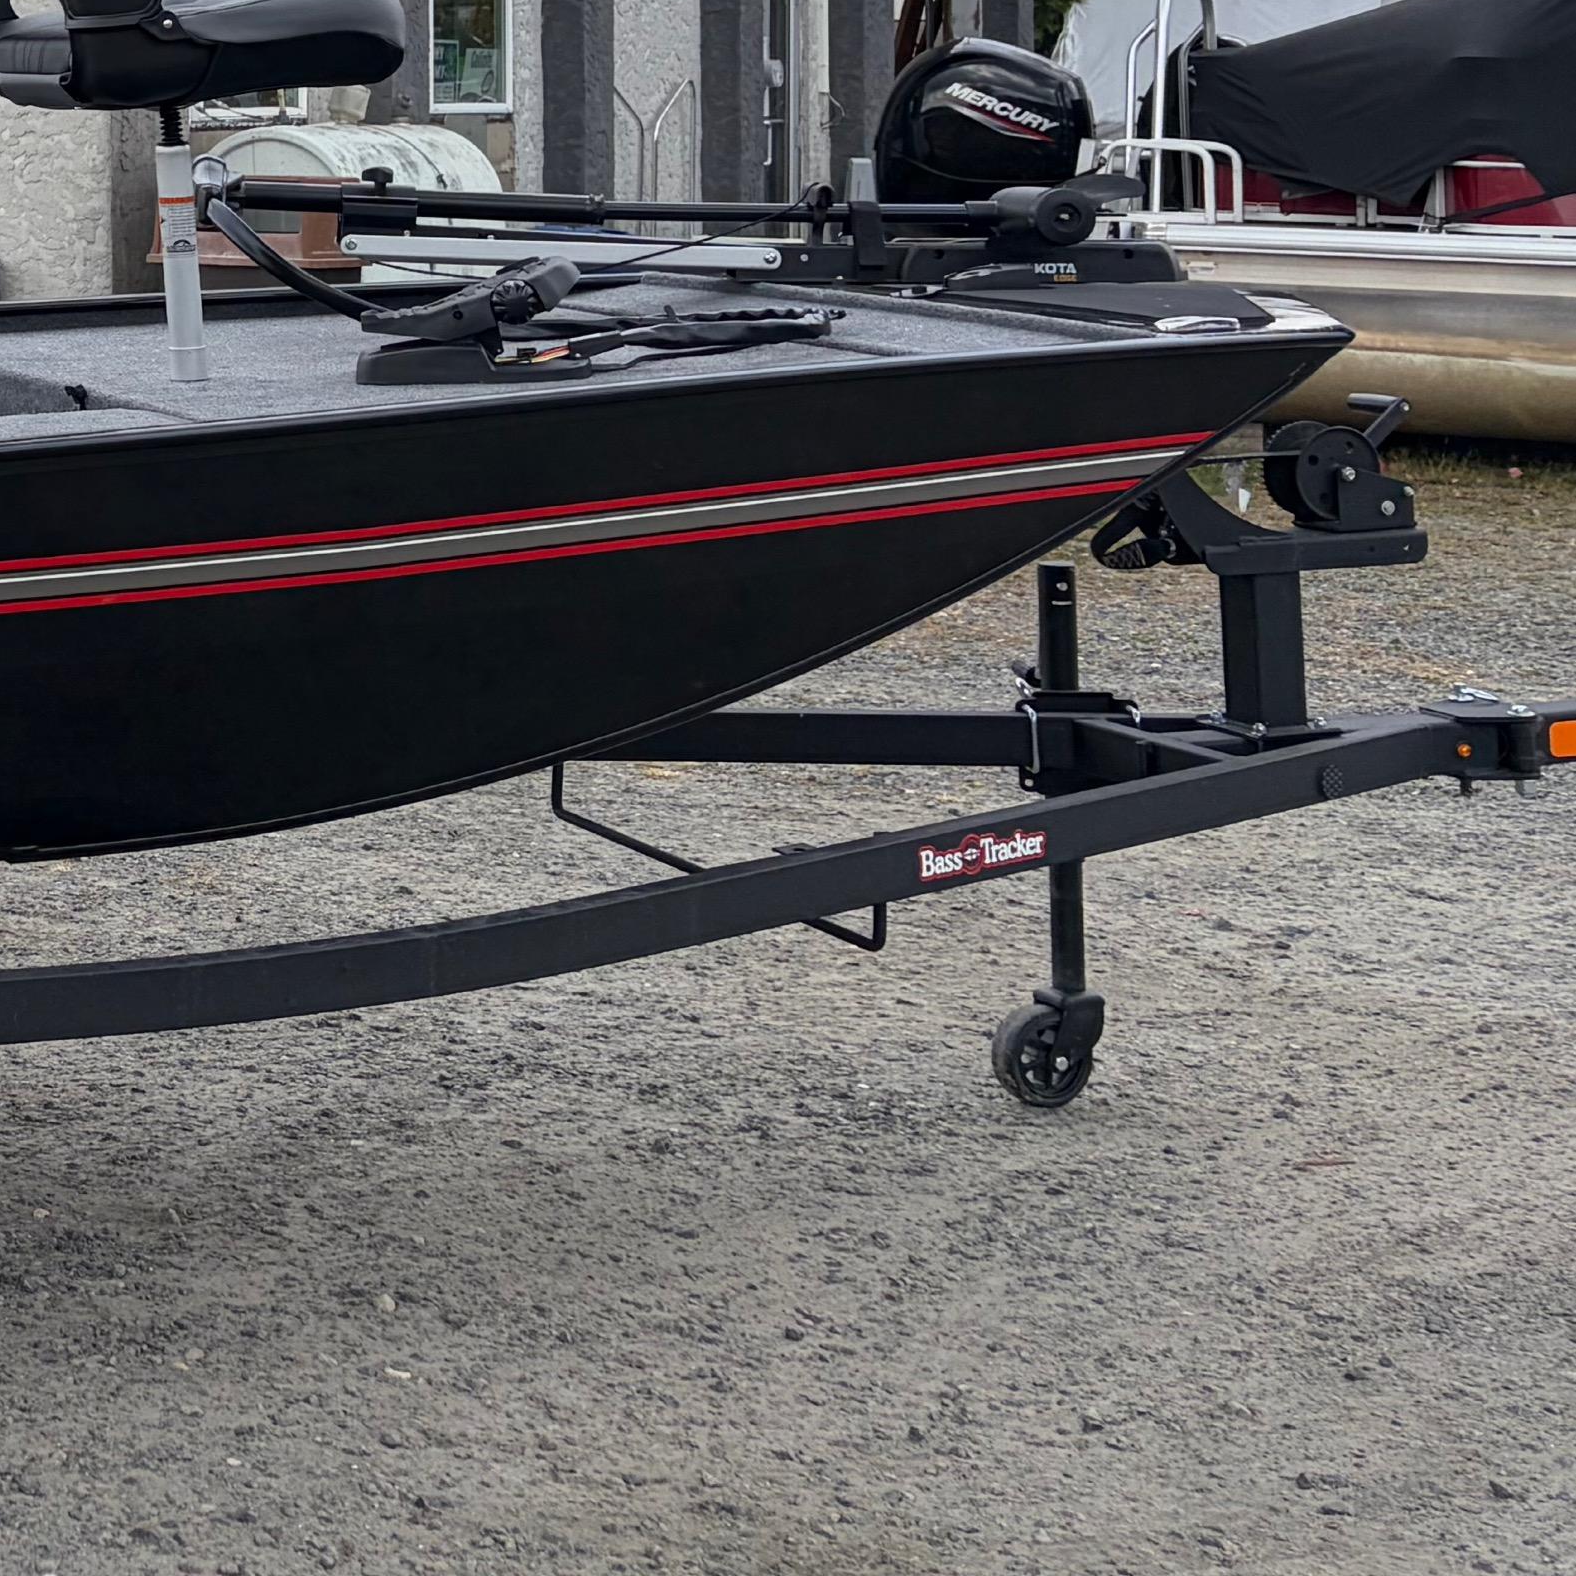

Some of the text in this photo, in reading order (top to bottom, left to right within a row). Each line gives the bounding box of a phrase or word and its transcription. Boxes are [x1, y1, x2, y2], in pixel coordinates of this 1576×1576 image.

[944, 82, 1060, 132] MERCURY
[1034, 262, 1077, 274] KOTA
[920, 832, 1044, 878] Bass Tracker
